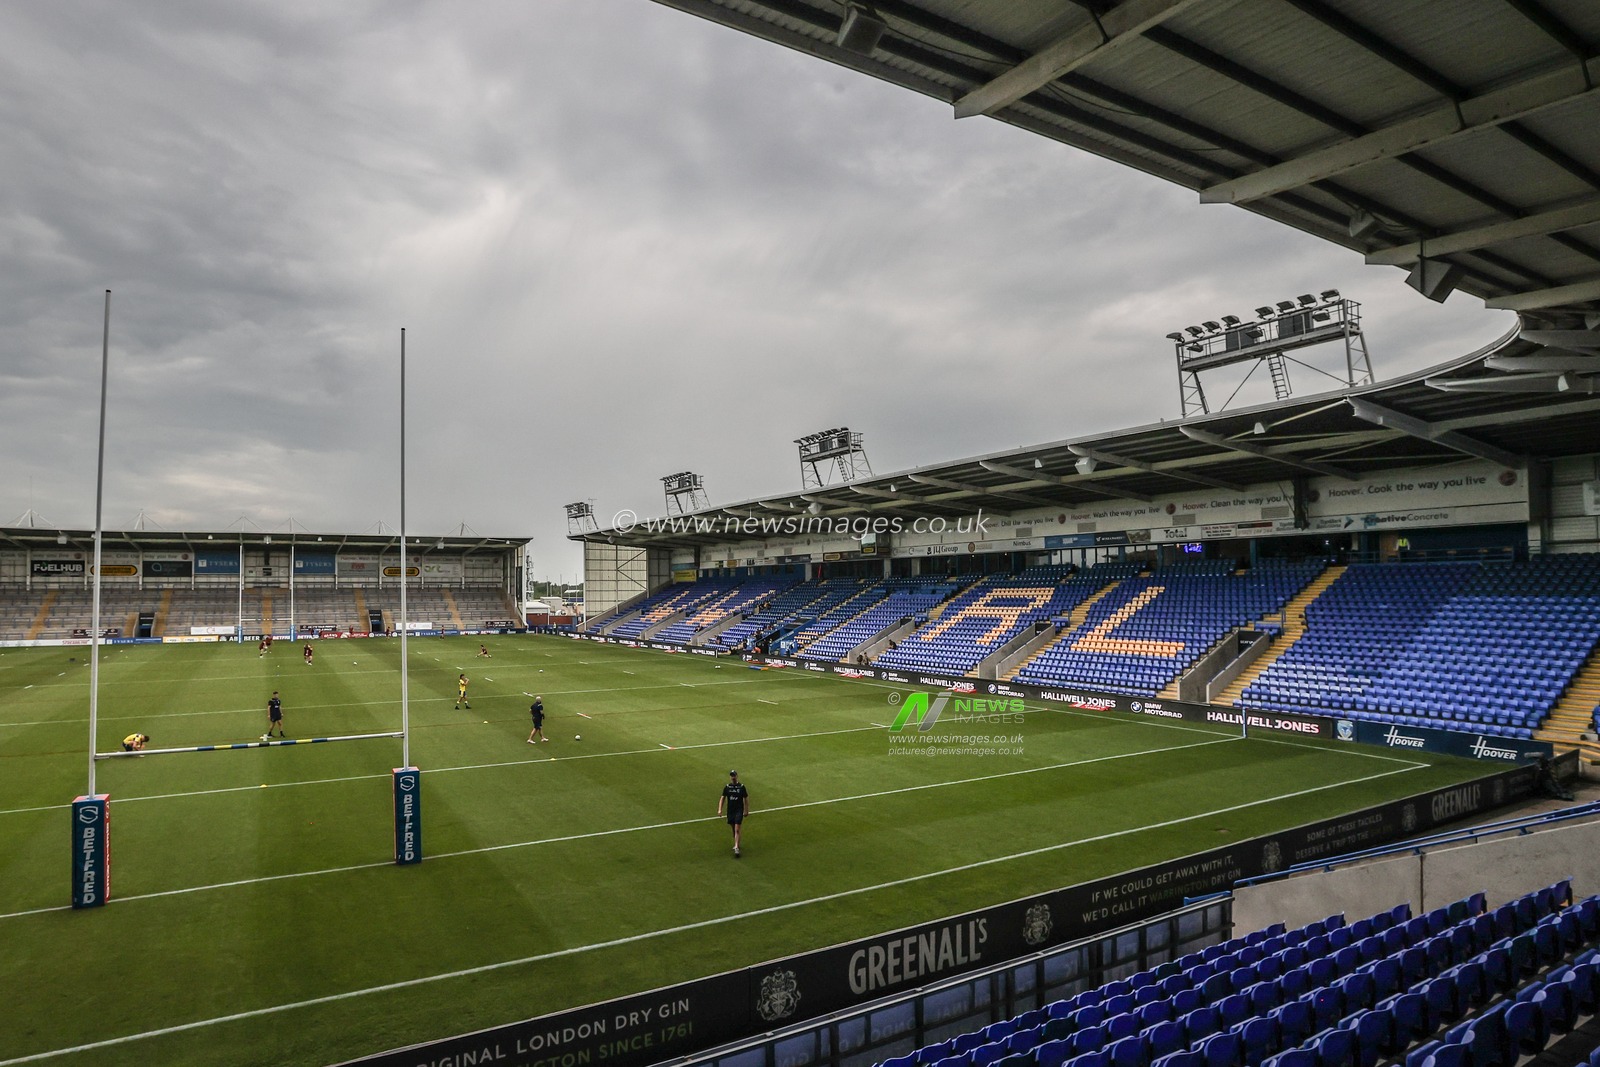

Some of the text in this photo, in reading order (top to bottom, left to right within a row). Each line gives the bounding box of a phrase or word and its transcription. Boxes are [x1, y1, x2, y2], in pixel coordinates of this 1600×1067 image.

[1368, 484, 1392, 494] Cook
[1397, 482, 1414, 492] the
[1418, 481, 1438, 490] way
[1443, 478, 1463, 488] you
[1466, 476, 1486, 486] live
[1210, 500, 1230, 508] Clean
[1266, 496, 1282, 504] you
[1165, 528, 1188, 538] Total
[34, 563, 82, 572] FUELHUB
[834, 666, 858, 674] HALLIWELL
[920, 677, 974, 690] HALLIWELL JONES
[998, 690, 1024, 698] MOTORRAD
[1041, 692, 1116, 708] HALLIWELL JONES
[1144, 708, 1182, 719] MOTORRAD
[1206, 712, 1320, 734] HALLIWELL JONES
[1432, 784, 1480, 821] GREENALL'S
[403, 794, 414, 860] BETFRED
[1307, 830, 1325, 842] SOME
[1328, 827, 1336, 837] OF
[1338, 821, 1356, 833] THESE
[1327, 842, 1331, 851] A
[1333, 838, 1346, 848] TRIP
[1348, 835, 1356, 844] TO
[1358, 831, 1369, 840] THE
[83, 828, 96, 904] BETFRED
[1092, 891, 1101, 903] IF
[1104, 887, 1118, 900] WE
[1121, 878, 1153, 894] COULD
[1156, 872, 1173, 885] GET
[1175, 865, 1199, 880] AWAY
[1201, 858, 1222, 872] WITH
[1082, 868, 1241, 924] WE'D CALL IT WARRINGTON DRY GIN
[849, 918, 987, 995] GREENALL'S
[516, 1019, 606, 1053] LONDON
[615, 1009, 653, 1030] DRY
[659, 998, 690, 1018] GIN
[599, 1032, 653, 1059] SINCE
[661, 1021, 692, 1043] 1761
